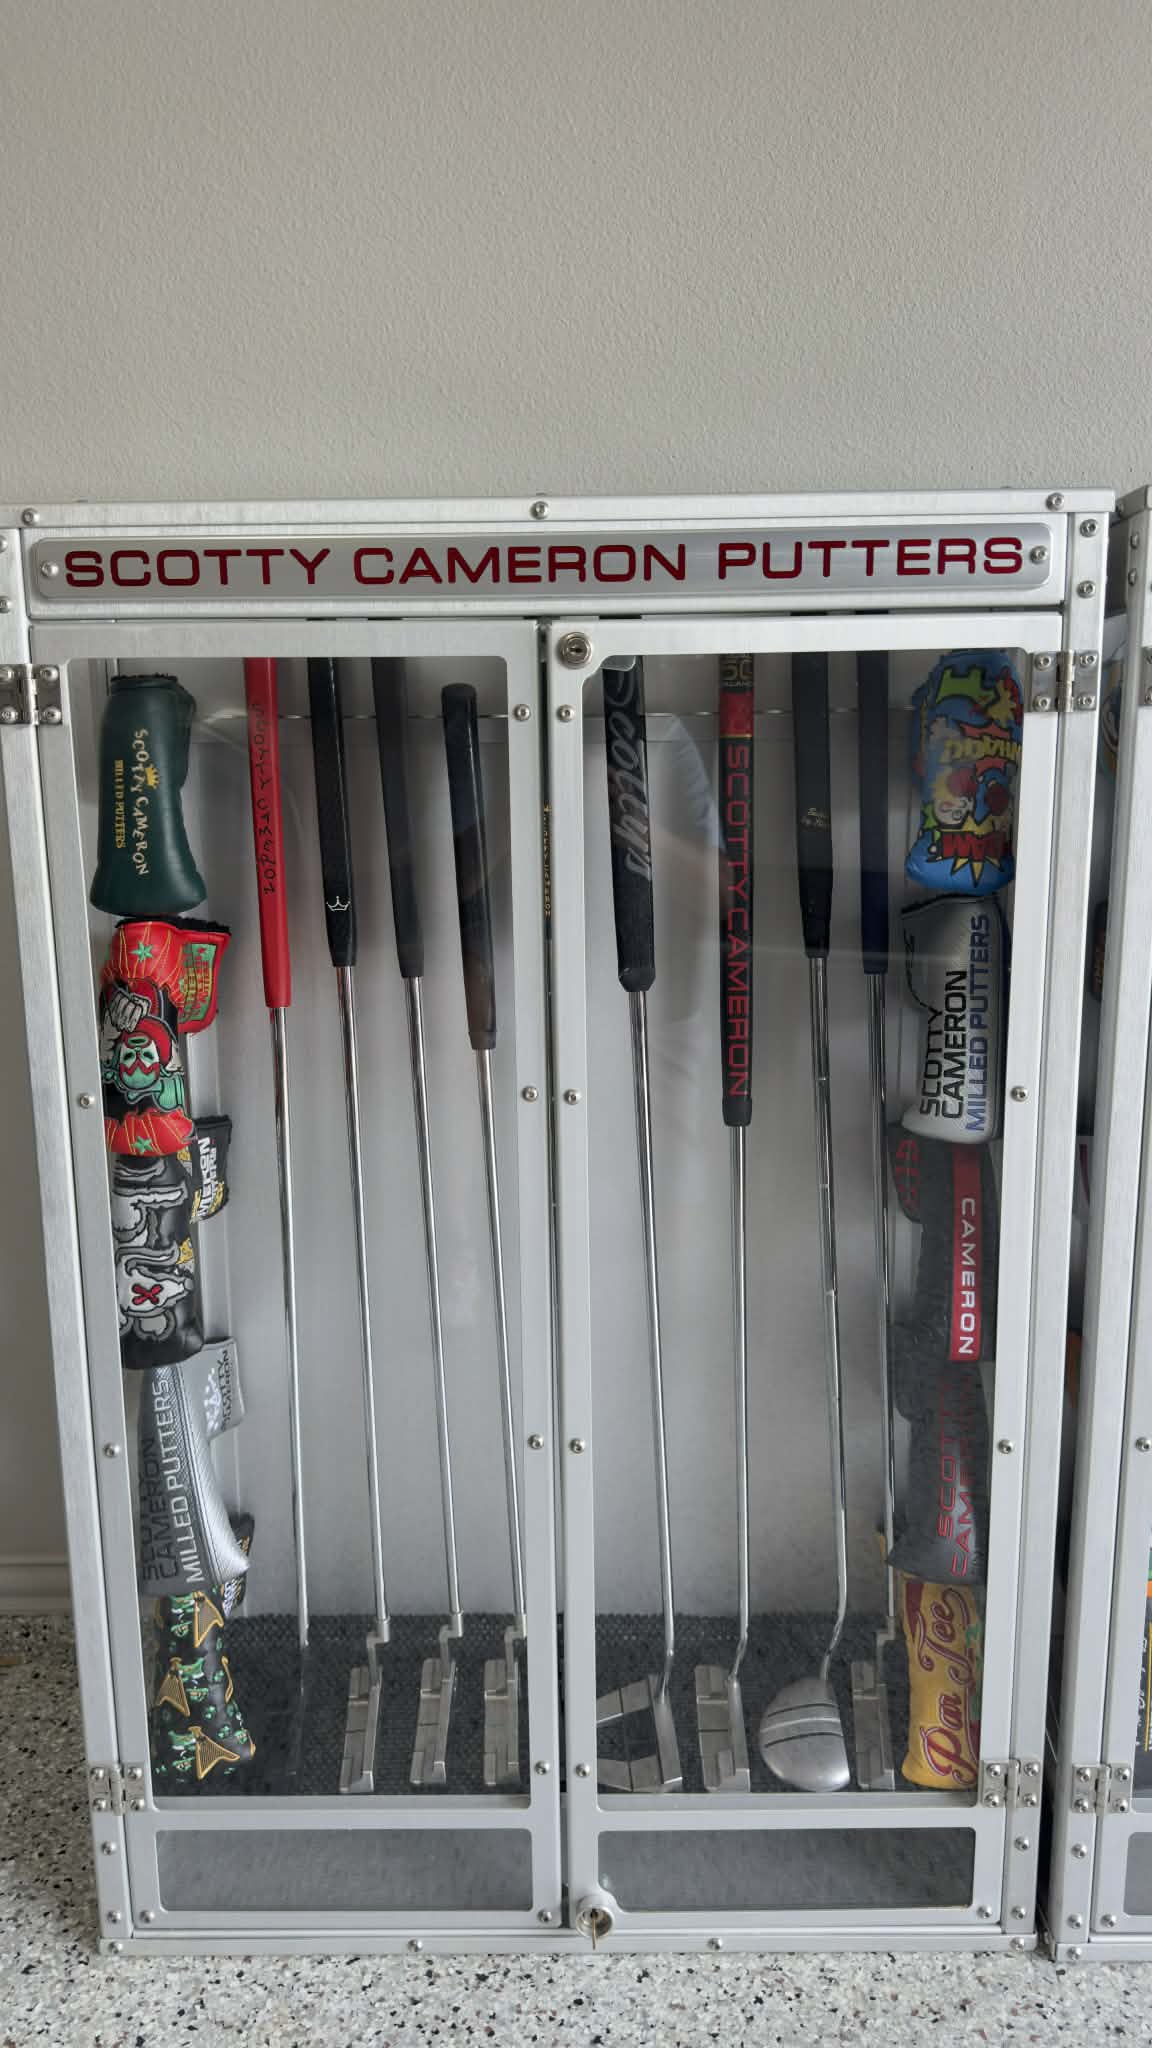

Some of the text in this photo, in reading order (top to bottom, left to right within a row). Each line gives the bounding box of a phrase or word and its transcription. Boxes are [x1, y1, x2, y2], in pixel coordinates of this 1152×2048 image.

[65, 536, 1023, 587] SCOTTY CAMERON PUTTERS
[131, 728, 150, 876] SCOTTY CAMERON
[726, 743, 750, 1097] SCOTTY CAMERON
[920, 1007, 943, 1117] SCOTTY
[942, 970, 968, 1119] CAMERON
[965, 914, 990, 1131] MILLED PUTTERS
[958, 1198, 976, 1355] CAMERON
[142, 1438, 180, 1580] CAMERON
[153, 1378, 205, 1583] MILLED PUTTERS
[951, 1377, 975, 1577] CAME
[917, 1592, 973, 1688] Tee
